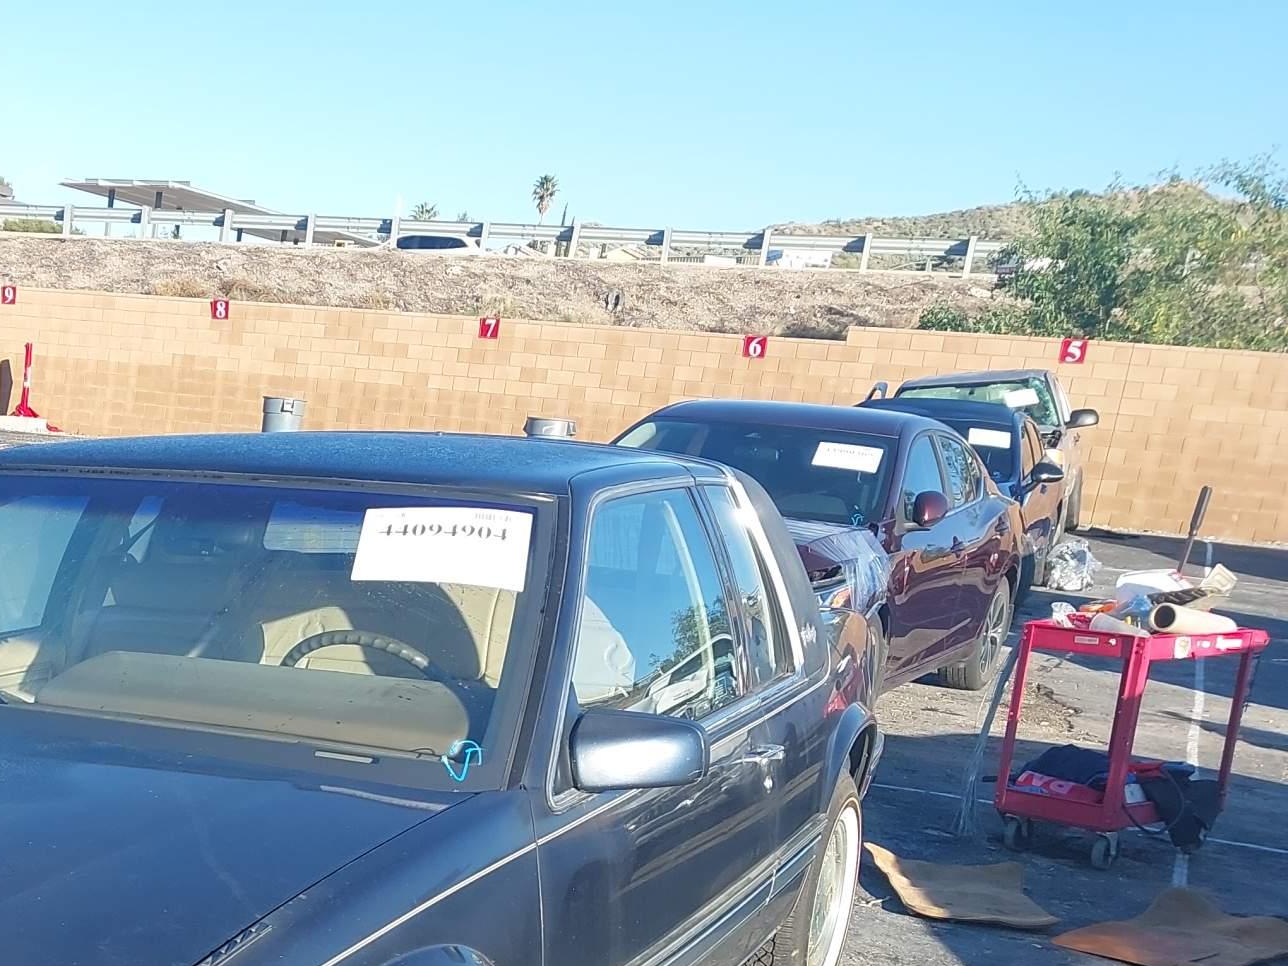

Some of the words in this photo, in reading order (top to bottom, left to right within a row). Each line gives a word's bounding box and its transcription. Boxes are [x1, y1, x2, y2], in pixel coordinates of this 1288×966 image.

[3, 286, 14, 304] 9
[214, 300, 227, 319] 8
[484, 318, 497, 337] 7
[748, 336, 763, 358] 6
[1064, 339, 1084, 363] 5
[376, 522, 509, 542] 44094904
